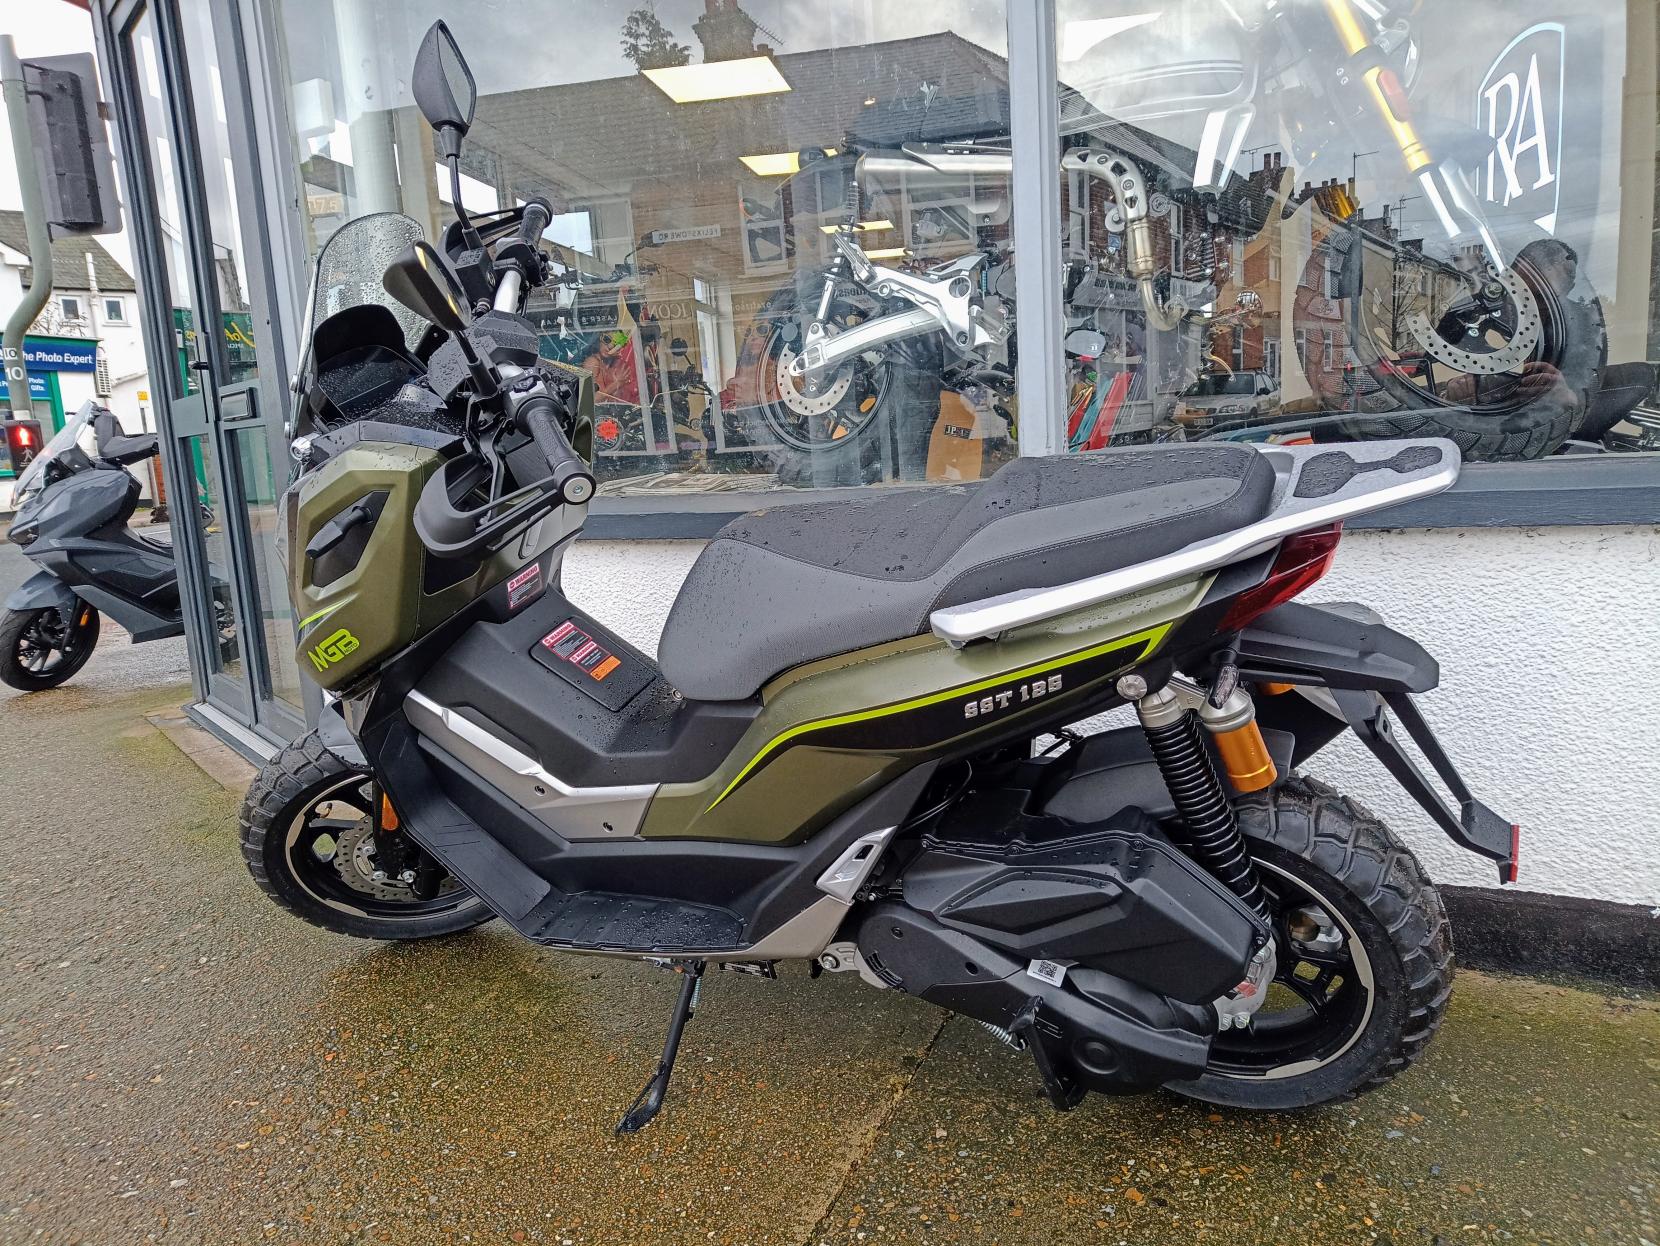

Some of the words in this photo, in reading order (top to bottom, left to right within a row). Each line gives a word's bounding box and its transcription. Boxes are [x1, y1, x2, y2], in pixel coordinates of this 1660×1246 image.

[22, 351, 34, 360] he
[36, 351, 62, 362] Photo
[64, 353, 93, 365] Expert
[5, 366, 24, 380] 10
[307, 628, 360, 672] MGB
[964, 690, 1013, 719] SST
[1019, 674, 1063, 703] 125
